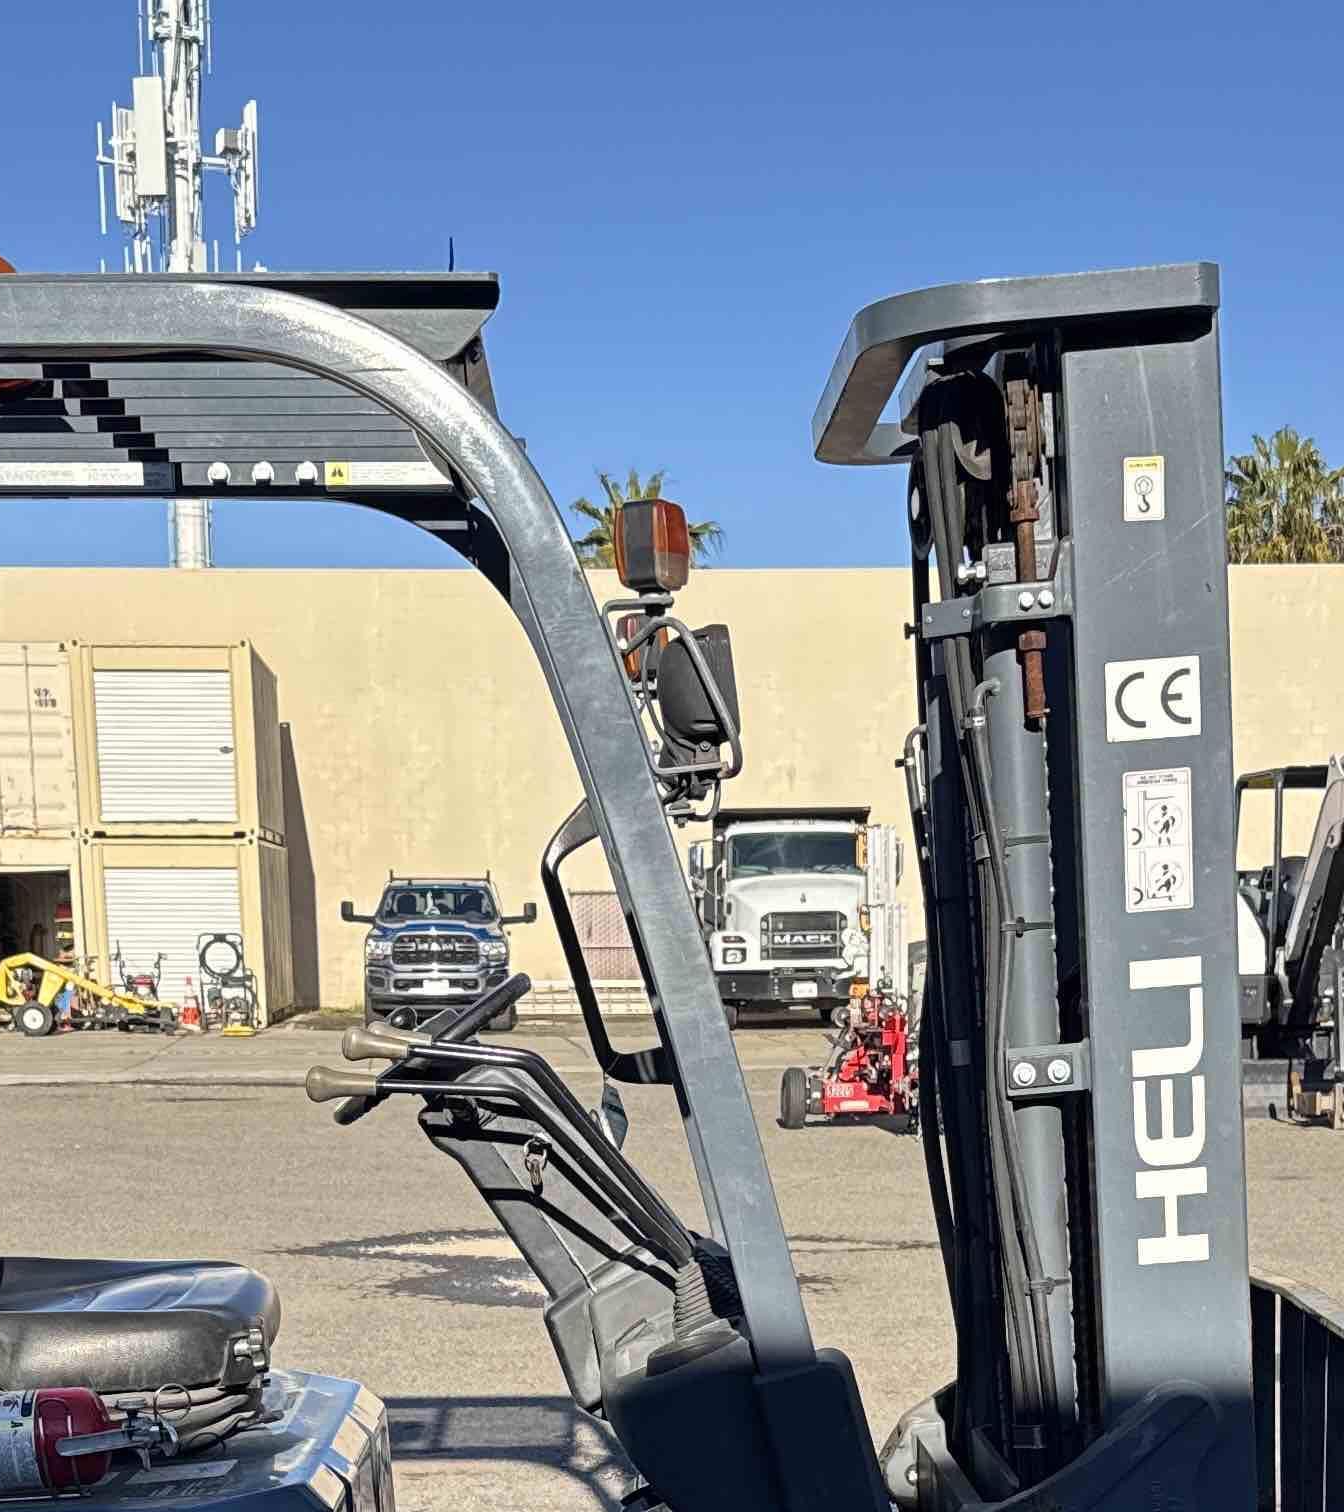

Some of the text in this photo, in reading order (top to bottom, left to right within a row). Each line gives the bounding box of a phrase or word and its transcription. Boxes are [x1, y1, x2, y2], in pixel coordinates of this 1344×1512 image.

[1115, 668, 1192, 728] CE
[774, 934, 833, 944] MACK
[1129, 956, 1209, 1265] HELI
